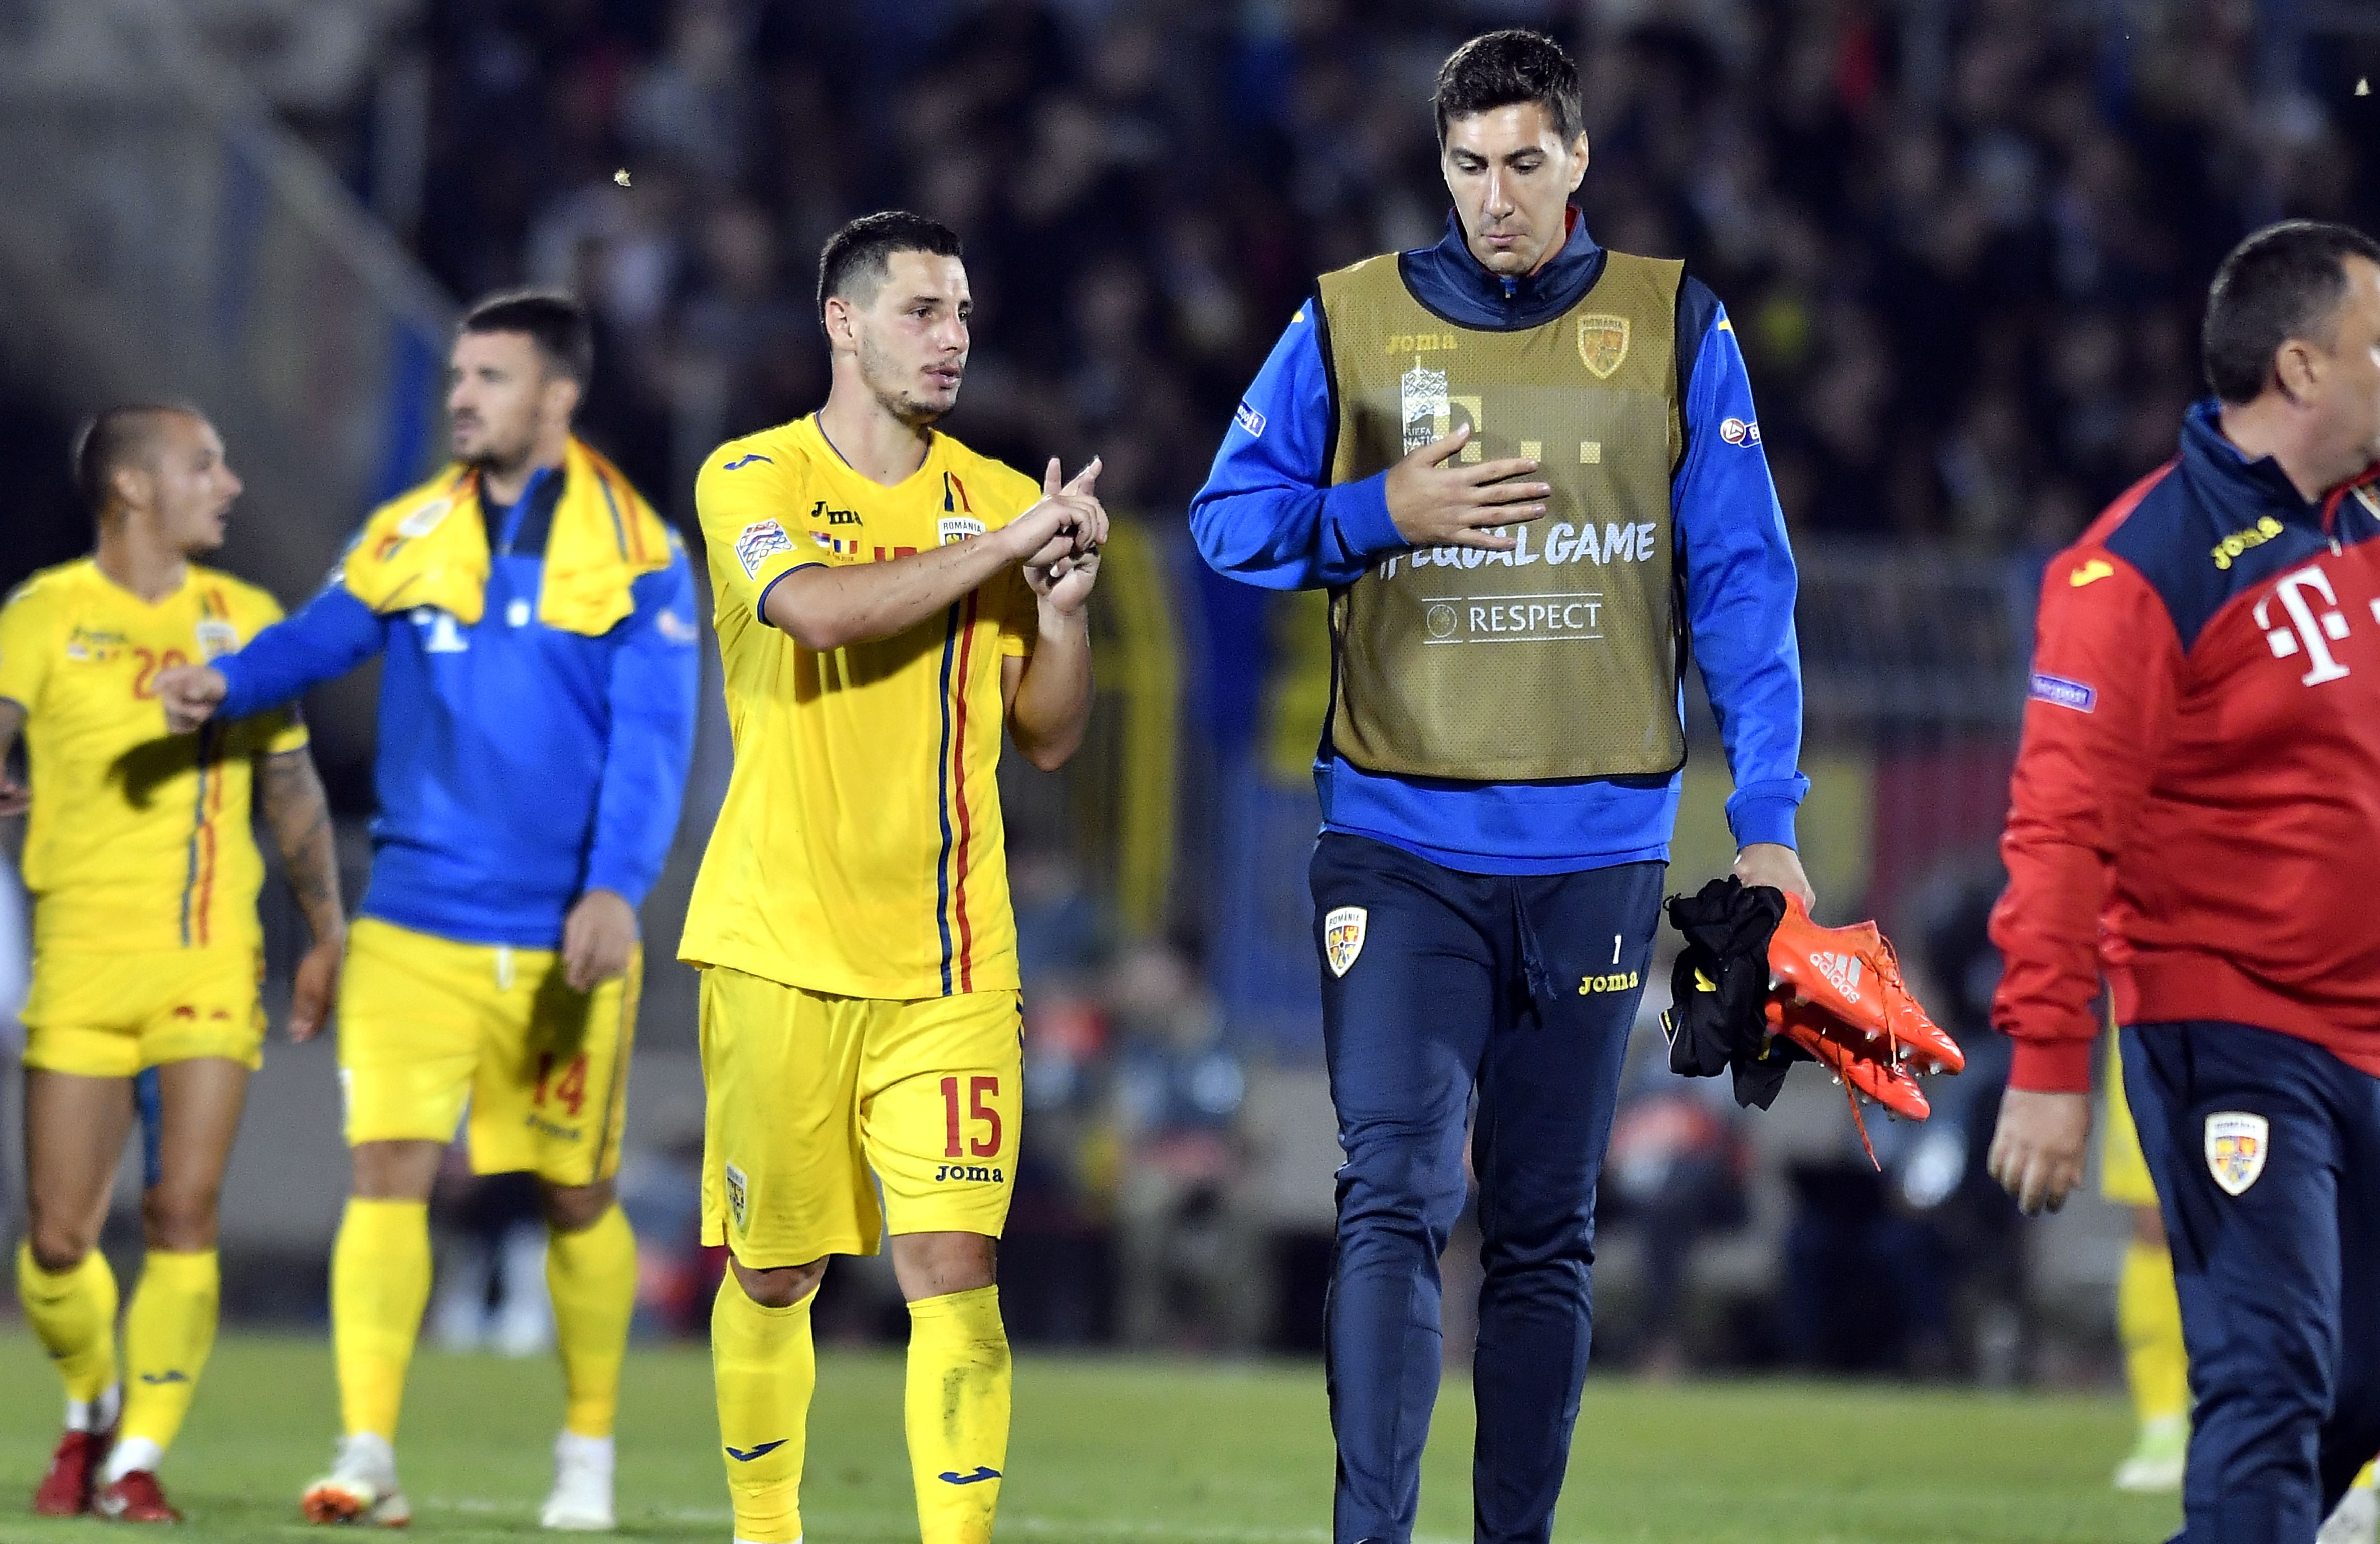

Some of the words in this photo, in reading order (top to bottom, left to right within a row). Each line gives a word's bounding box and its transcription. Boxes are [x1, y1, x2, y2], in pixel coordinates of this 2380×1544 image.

[943, 519, 982, 533] ROMÂNIA
[1545, 523, 1657, 566] GAME
[1468, 603, 1602, 632] RESPECT
[1810, 953, 1860, 1004] adidas
[534, 1052, 589, 1116] 14
[940, 1076, 1002, 1158] 15
